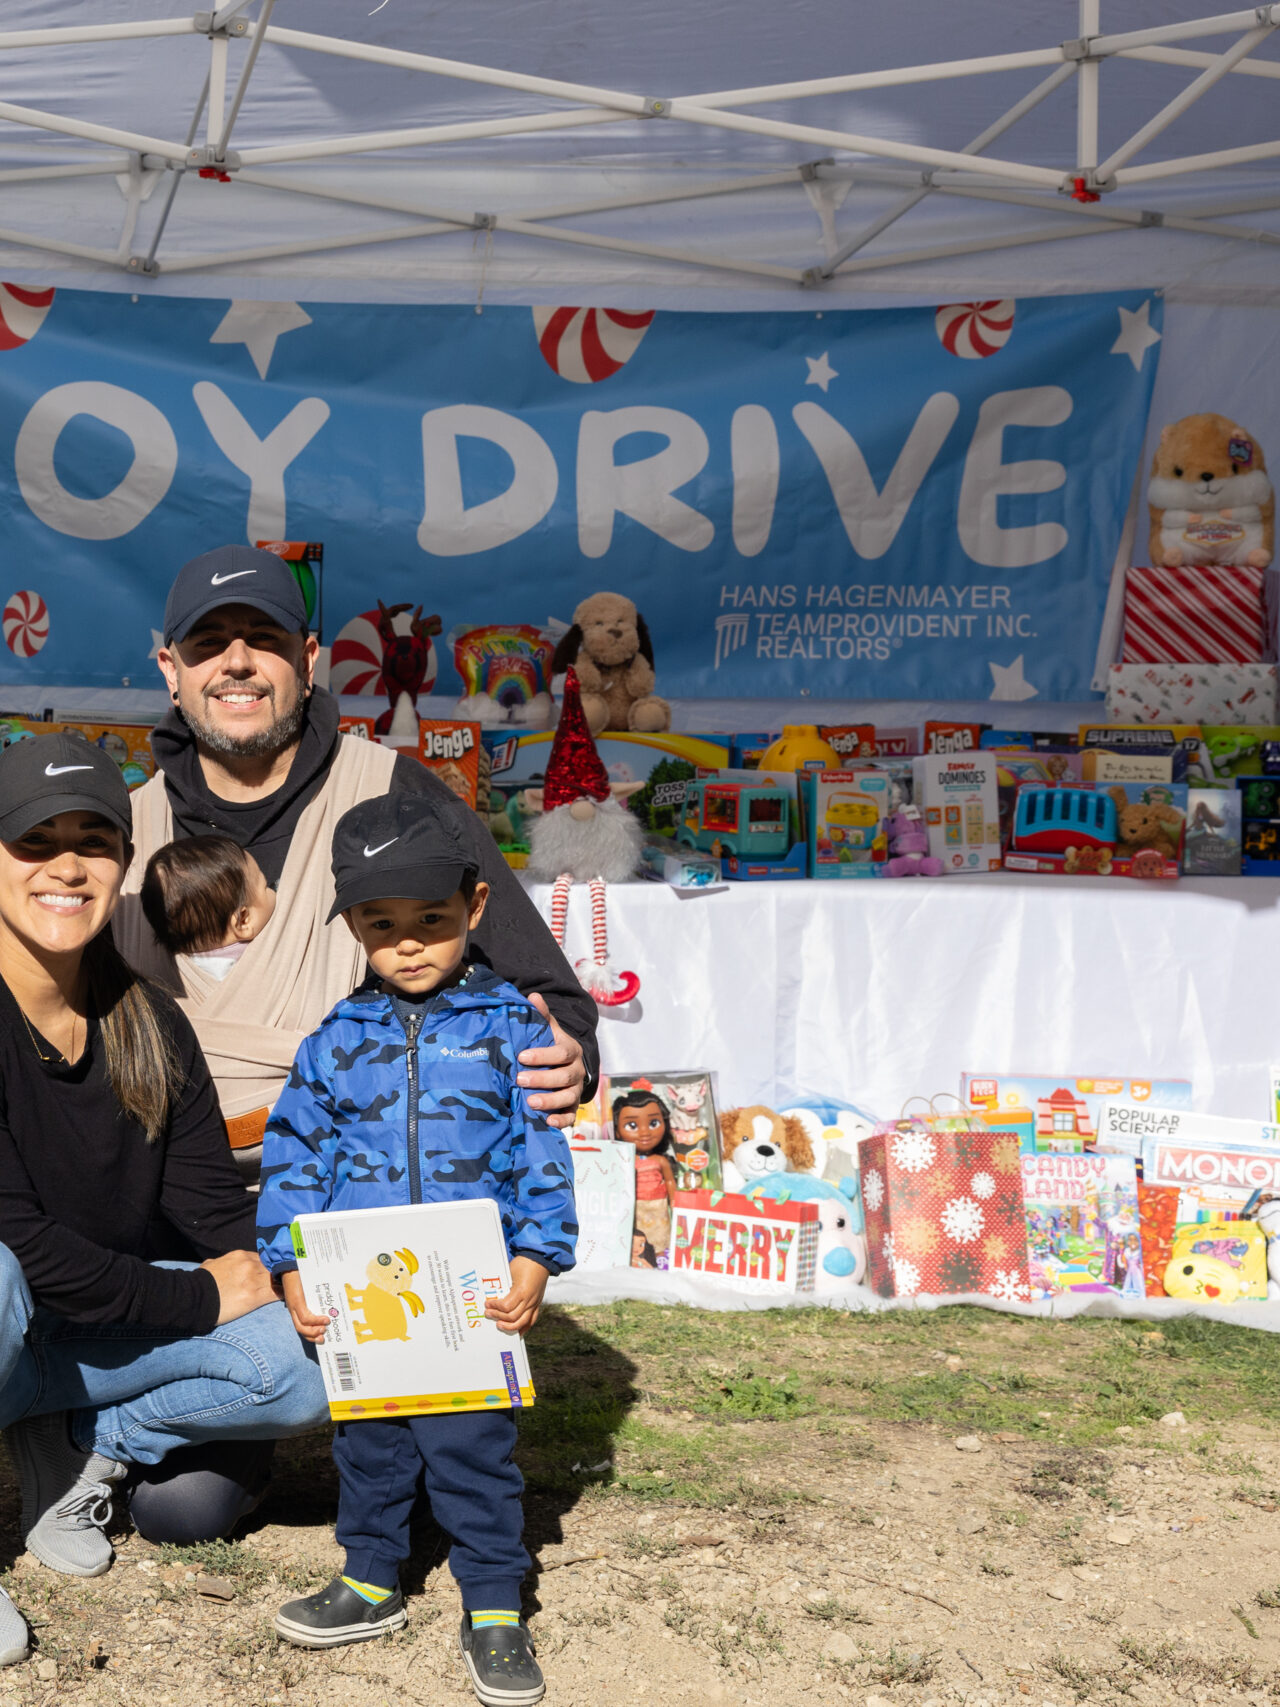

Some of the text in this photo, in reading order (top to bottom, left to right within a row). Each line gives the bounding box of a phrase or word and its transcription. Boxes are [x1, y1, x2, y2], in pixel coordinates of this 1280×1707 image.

[416, 384, 1076, 568] DRIVE
[719, 585, 1011, 609] HANS HAGENMAYER
[755, 613, 1038, 638] TEAMPROVIDENT INC.
[424, 727, 474, 760] Jenga
[827, 731, 859, 754] Jenga
[928, 728, 974, 754] Jenga
[1086, 730, 1175, 743] SUPREME
[657, 782, 684, 794] TOSS
[938, 771, 987, 785] DOMINOES
[1108, 1107, 1181, 1127] POPULAR
[1110, 1120, 1178, 1135] SCIENCE
[1020, 1155, 1106, 1178] CANDY
[1021, 1178, 1085, 1200] LAND
[576, 1190, 618, 1217] NGLE
[674, 1215, 796, 1282] MERRY
[457, 1268, 487, 1329] Words
[482, 1277, 504, 1302] Fir
[322, 1283, 342, 1342] priddy books
[503, 1353, 518, 1394] Alphaprints
